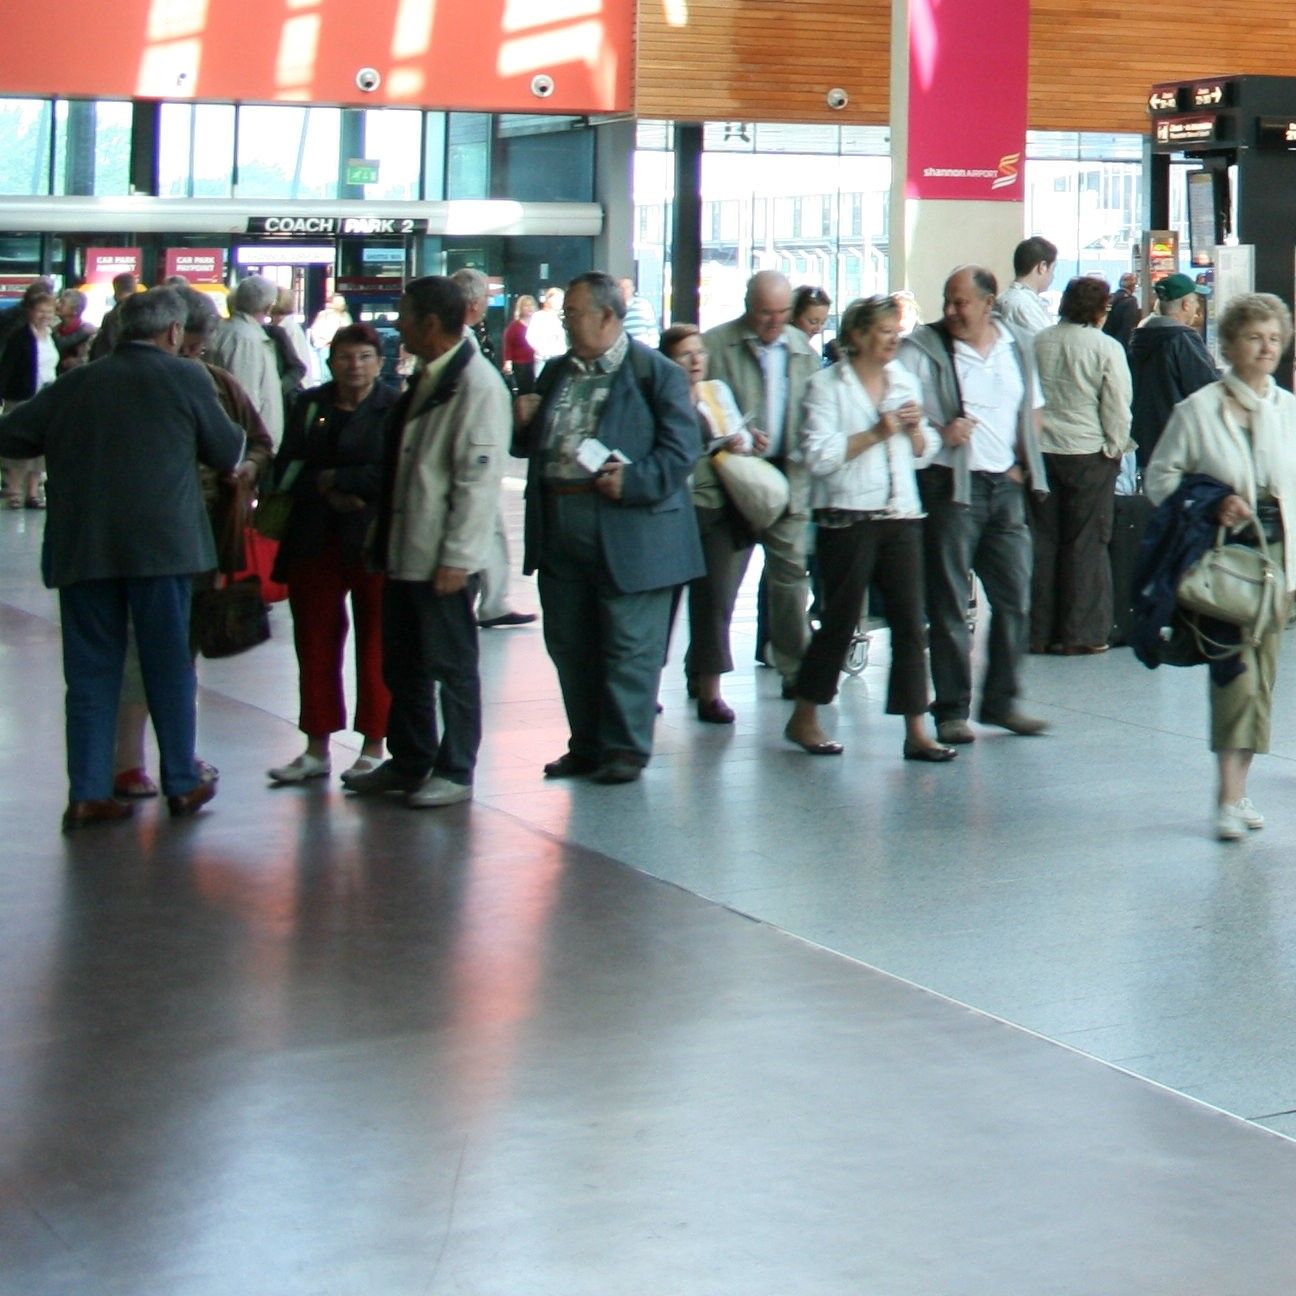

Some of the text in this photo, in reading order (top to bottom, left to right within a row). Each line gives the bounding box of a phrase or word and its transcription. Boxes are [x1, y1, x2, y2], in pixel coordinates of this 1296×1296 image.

[923, 167, 999, 178] shannon AIRPORT
[265, 217, 415, 233] COACH PARK 2
[96, 256, 136, 264] CAR PARK
[176, 256, 215, 264] CAR PARK
